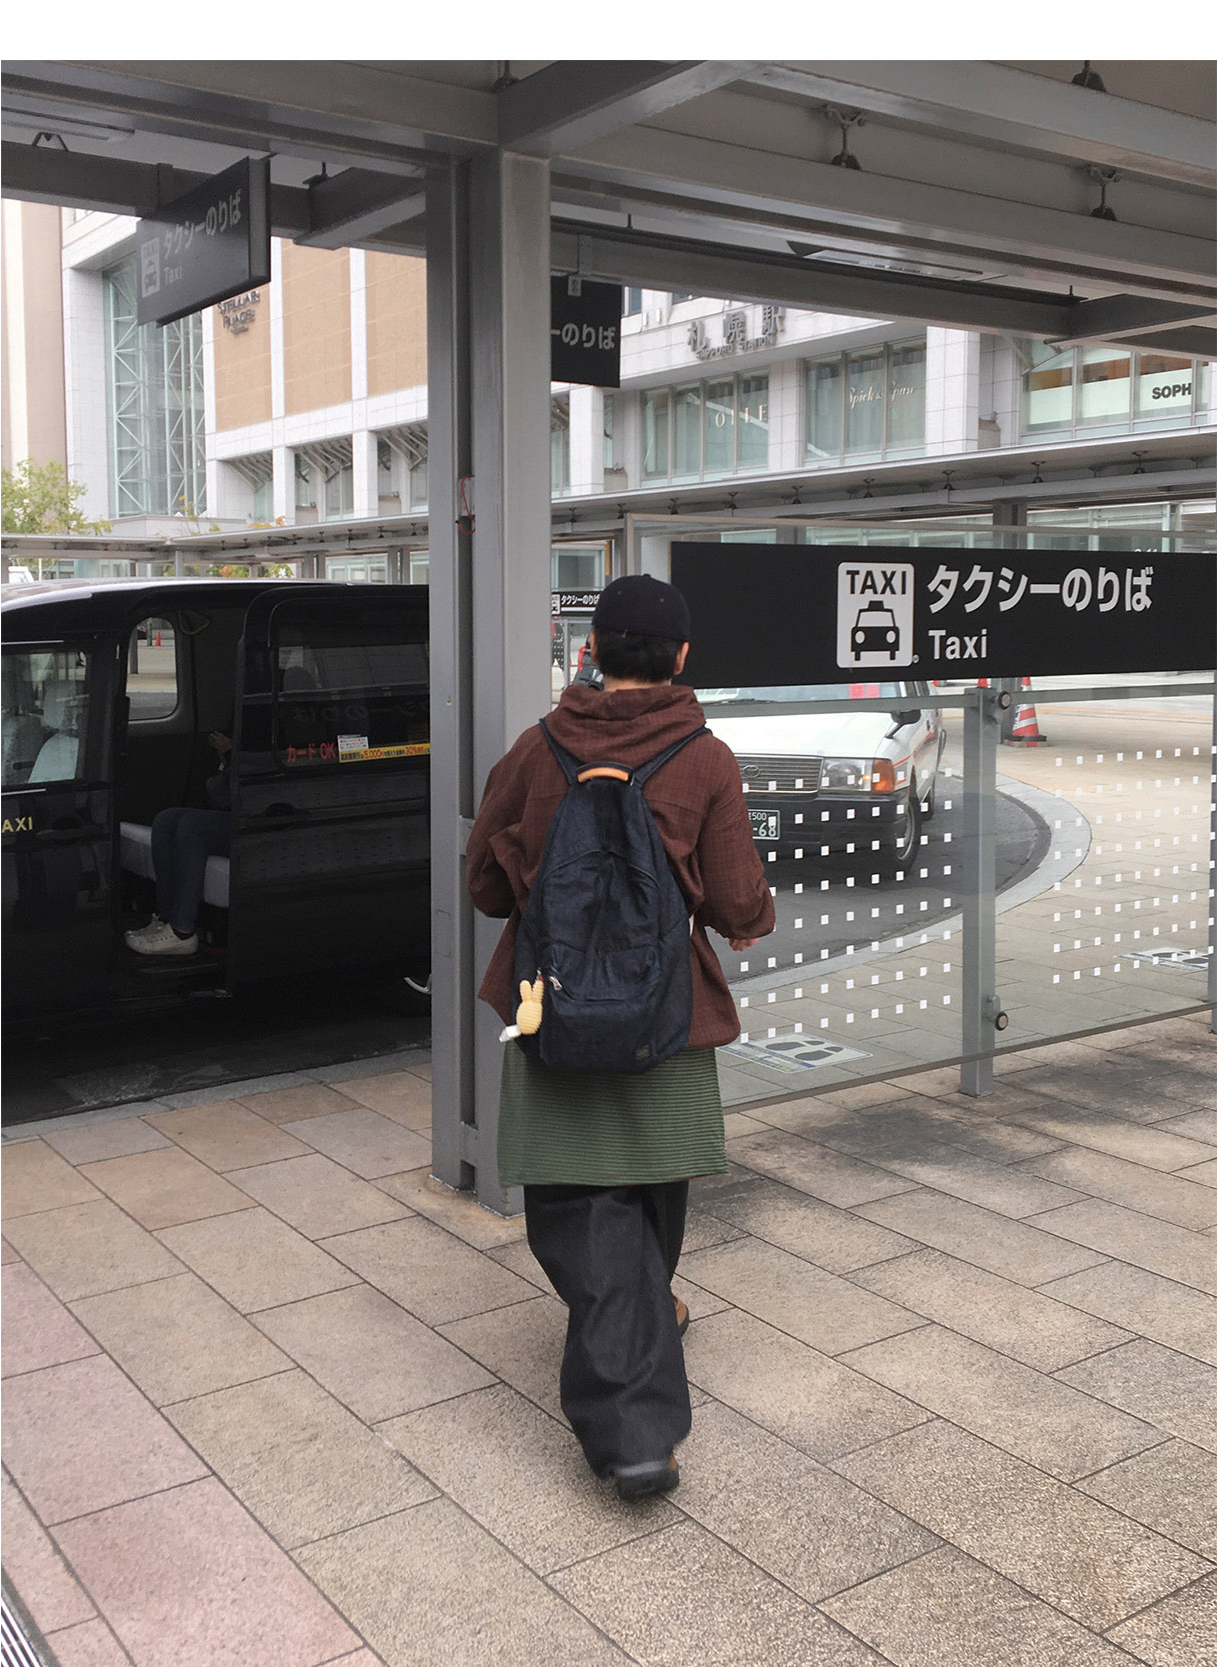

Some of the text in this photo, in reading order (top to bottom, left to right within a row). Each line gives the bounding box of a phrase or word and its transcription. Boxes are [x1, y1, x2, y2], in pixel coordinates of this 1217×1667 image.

[163, 188, 241, 260] タクシーのりば
[846, 569, 907, 595] TAXI
[927, 564, 1154, 613] タクシーのりば
[928, 628, 988, 660] Taxi
[286, 743, 316, 763] カード
[320, 742, 336, 759] OK
